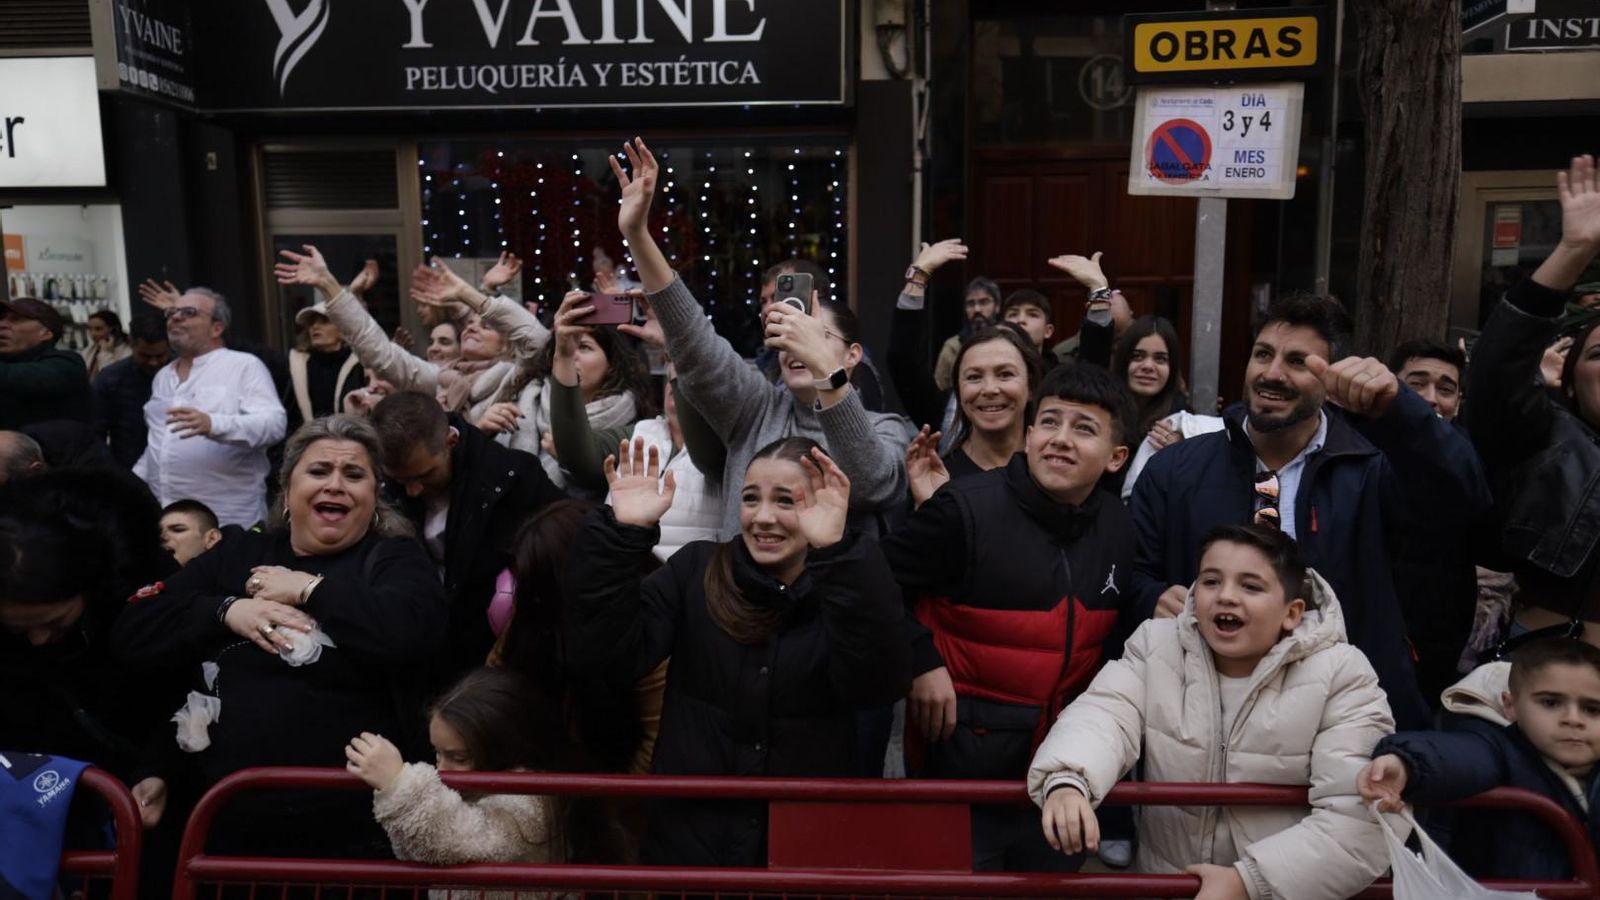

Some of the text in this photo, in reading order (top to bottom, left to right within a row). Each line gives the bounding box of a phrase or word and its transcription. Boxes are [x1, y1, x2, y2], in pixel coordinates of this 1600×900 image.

[119, 5, 183, 55] YVAINE
[1150, 26, 1303, 63] OBRAS
[405, 55, 761, 94] PELUQUERÍA Y ESTÉTICA
[1092, 65, 1124, 99] 14
[1223, 110, 1272, 138] 3 y 4
[1225, 167, 1266, 178] ENERO
[1234, 150, 1265, 164] MES
[37, 777, 71, 808] YAMAHA
